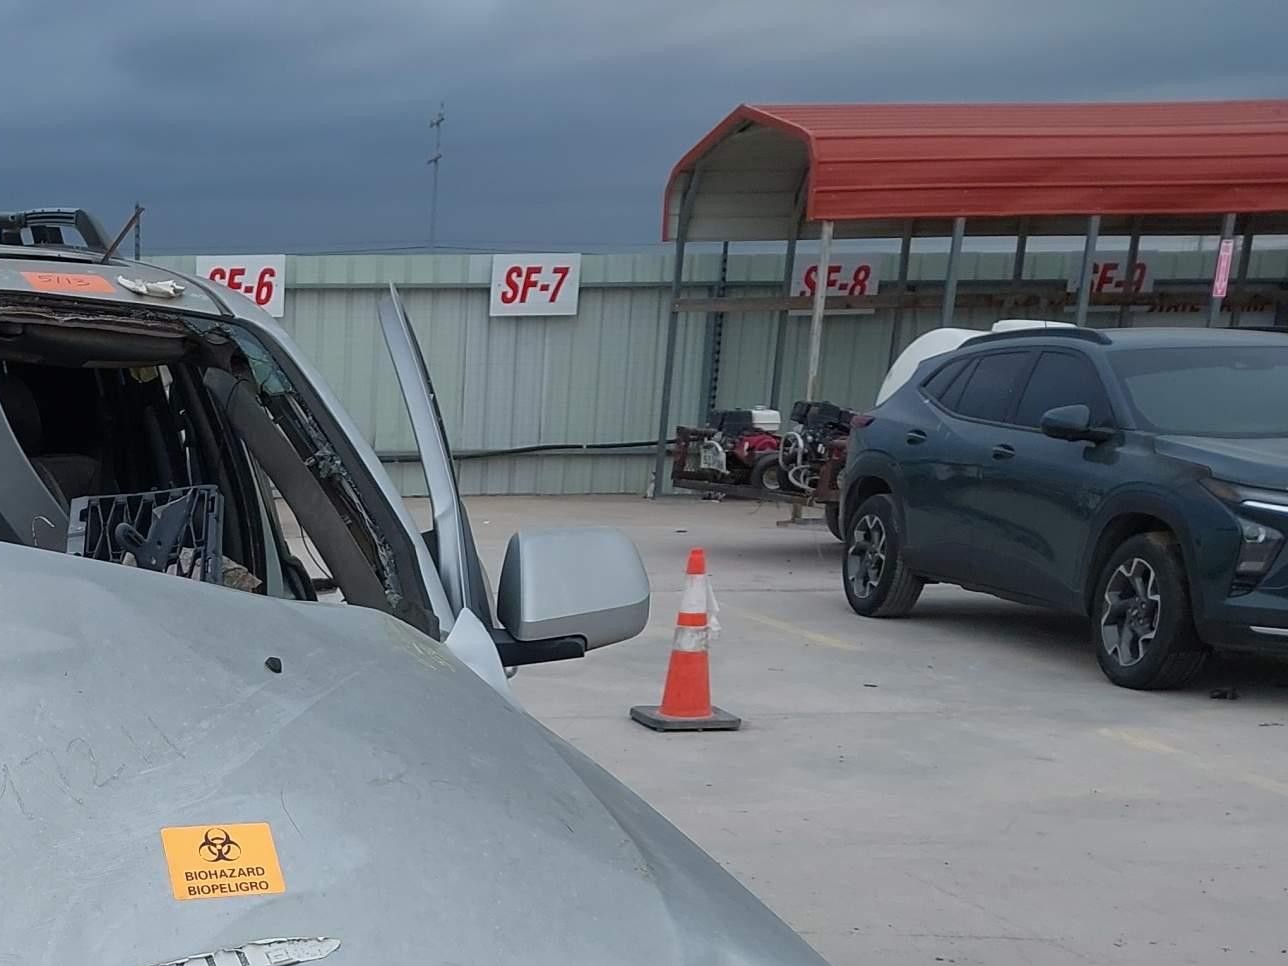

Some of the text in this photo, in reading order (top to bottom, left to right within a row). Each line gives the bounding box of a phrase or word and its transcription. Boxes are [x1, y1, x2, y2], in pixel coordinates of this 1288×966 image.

[500, 266, 570, 305] SF-7
[185, 866, 265, 881] BIOHAZARD
[188, 880, 269, 896] BIOPELIGRO
